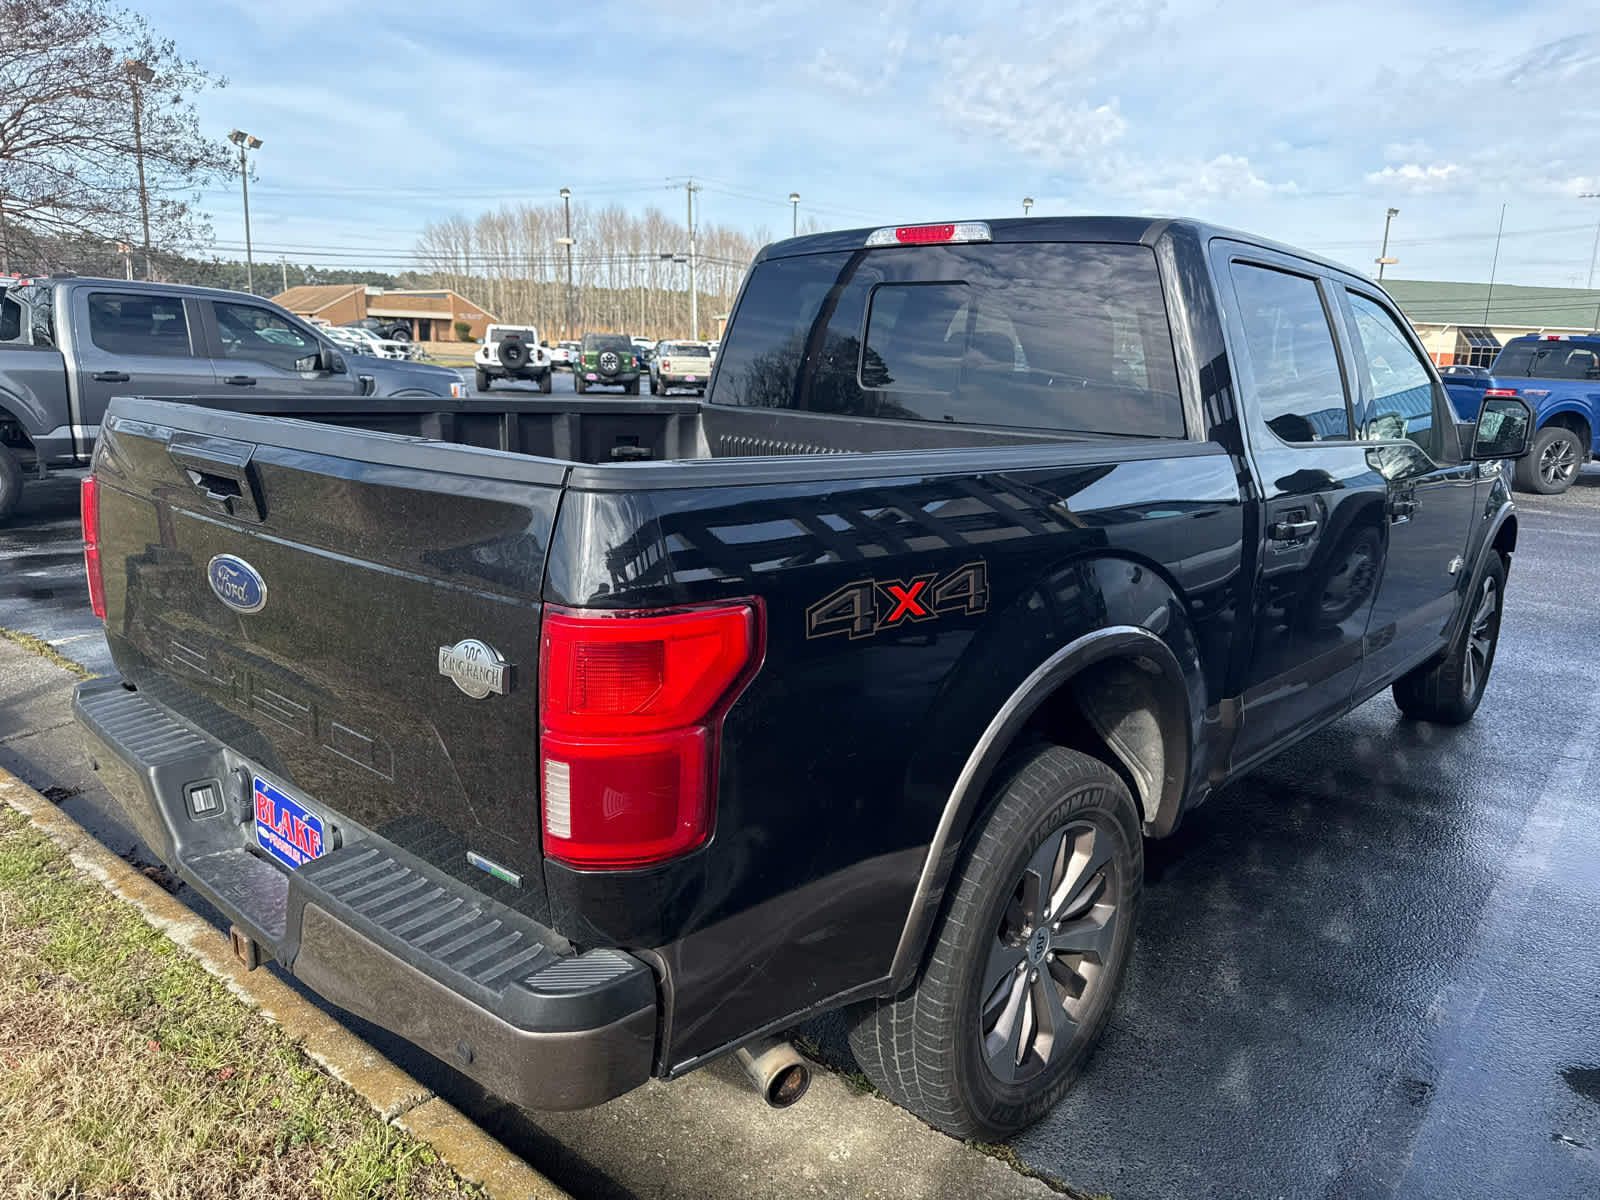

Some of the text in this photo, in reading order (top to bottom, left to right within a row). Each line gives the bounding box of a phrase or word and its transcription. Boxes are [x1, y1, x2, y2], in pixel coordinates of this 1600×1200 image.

[215, 565, 248, 601] Ford
[442, 652, 499, 687] KING RANCH
